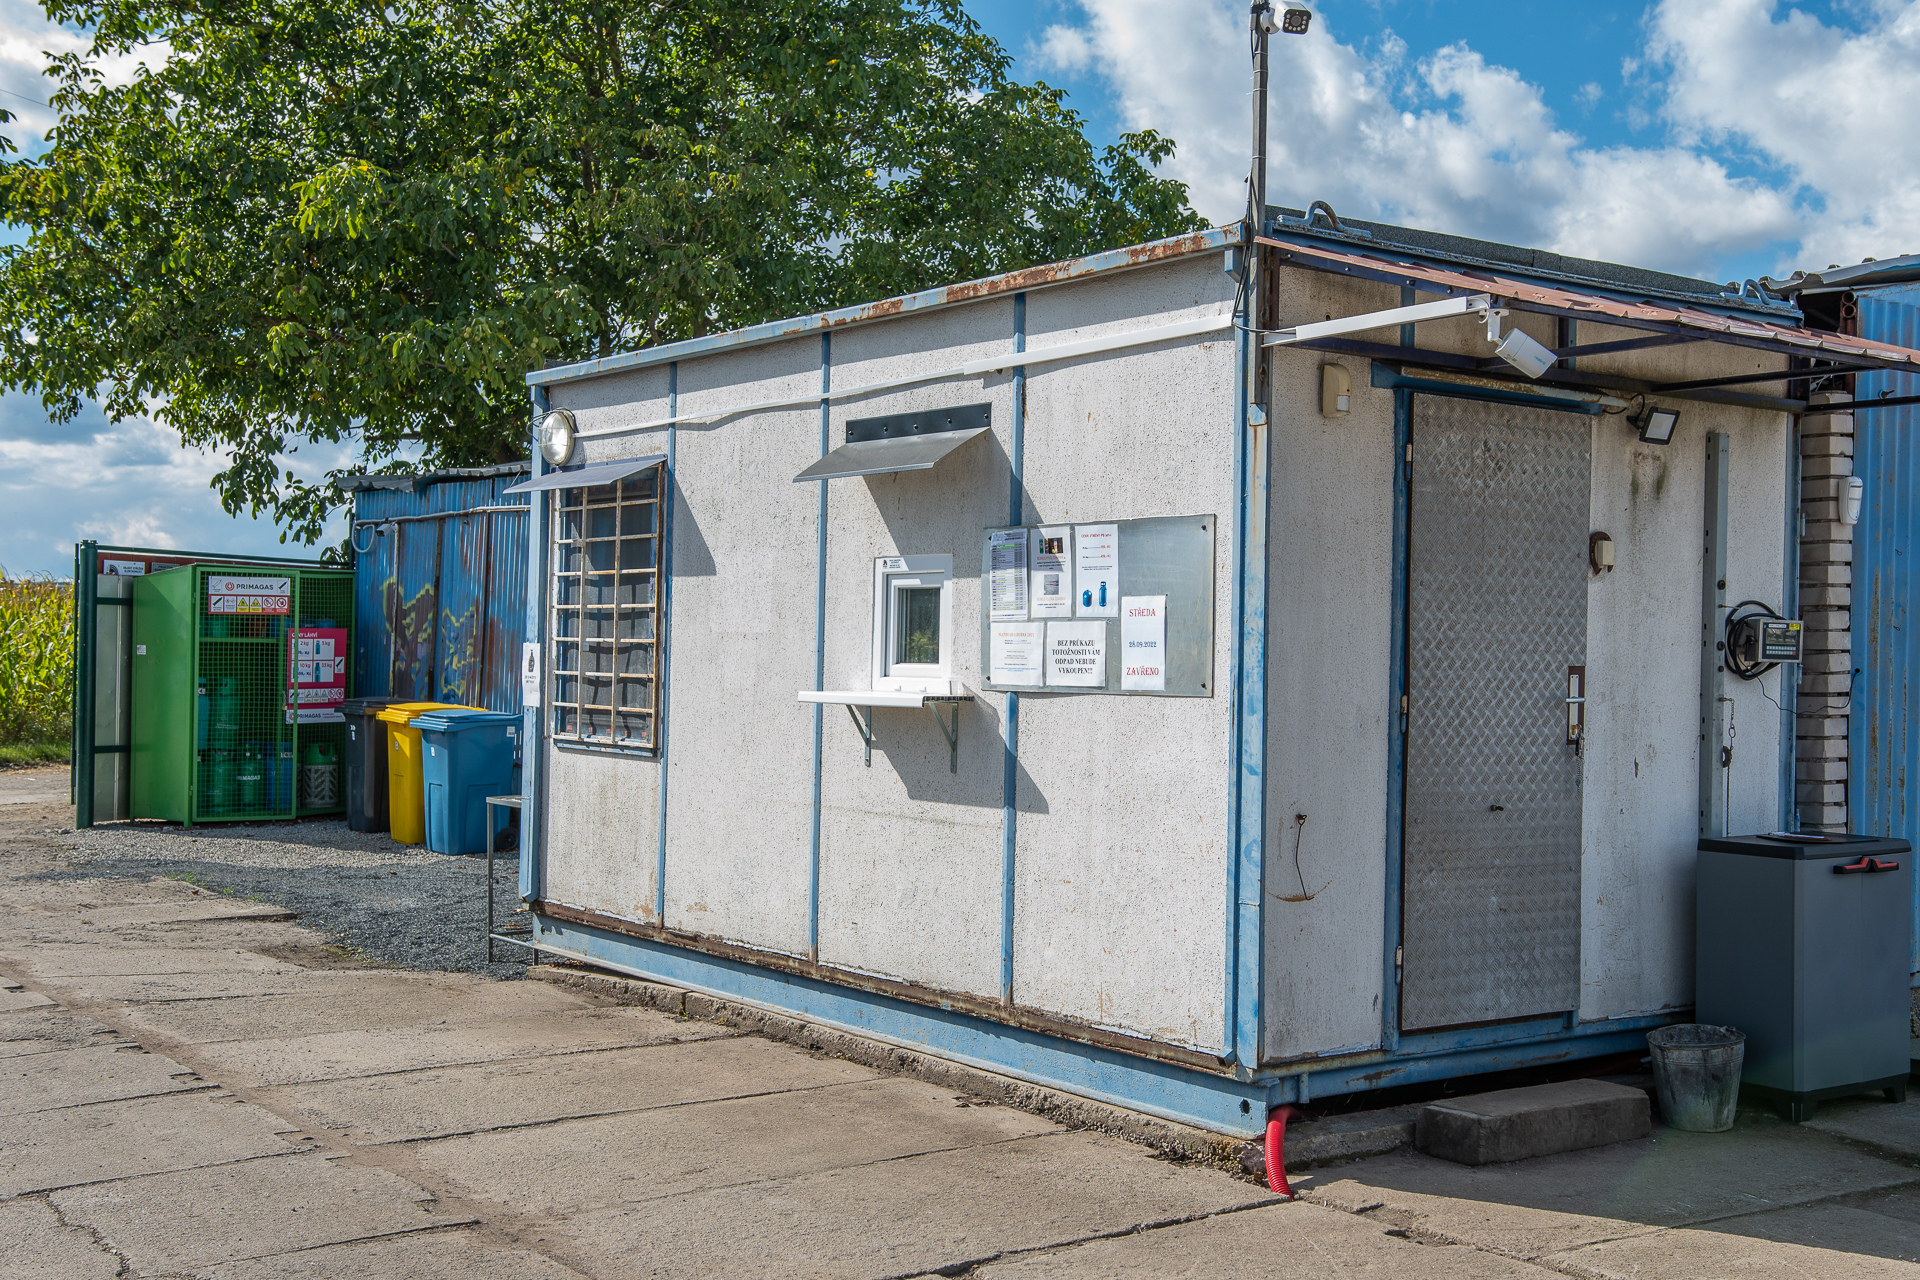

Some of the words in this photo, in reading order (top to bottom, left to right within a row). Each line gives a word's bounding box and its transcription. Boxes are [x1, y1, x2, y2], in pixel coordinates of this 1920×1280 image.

[236, 583, 274, 591] PRIMAGAS
[1129, 607, 1156, 617] STŘEDA
[1069, 638, 1095, 646] PRŮKAZU
[1128, 640, 1157, 648] 28.09.2022
[1052, 647, 1087, 656] TOTOŽNOSTI
[1087, 647, 1100, 656] VÁM
[1126, 665, 1159, 676] ZAVŘENO
